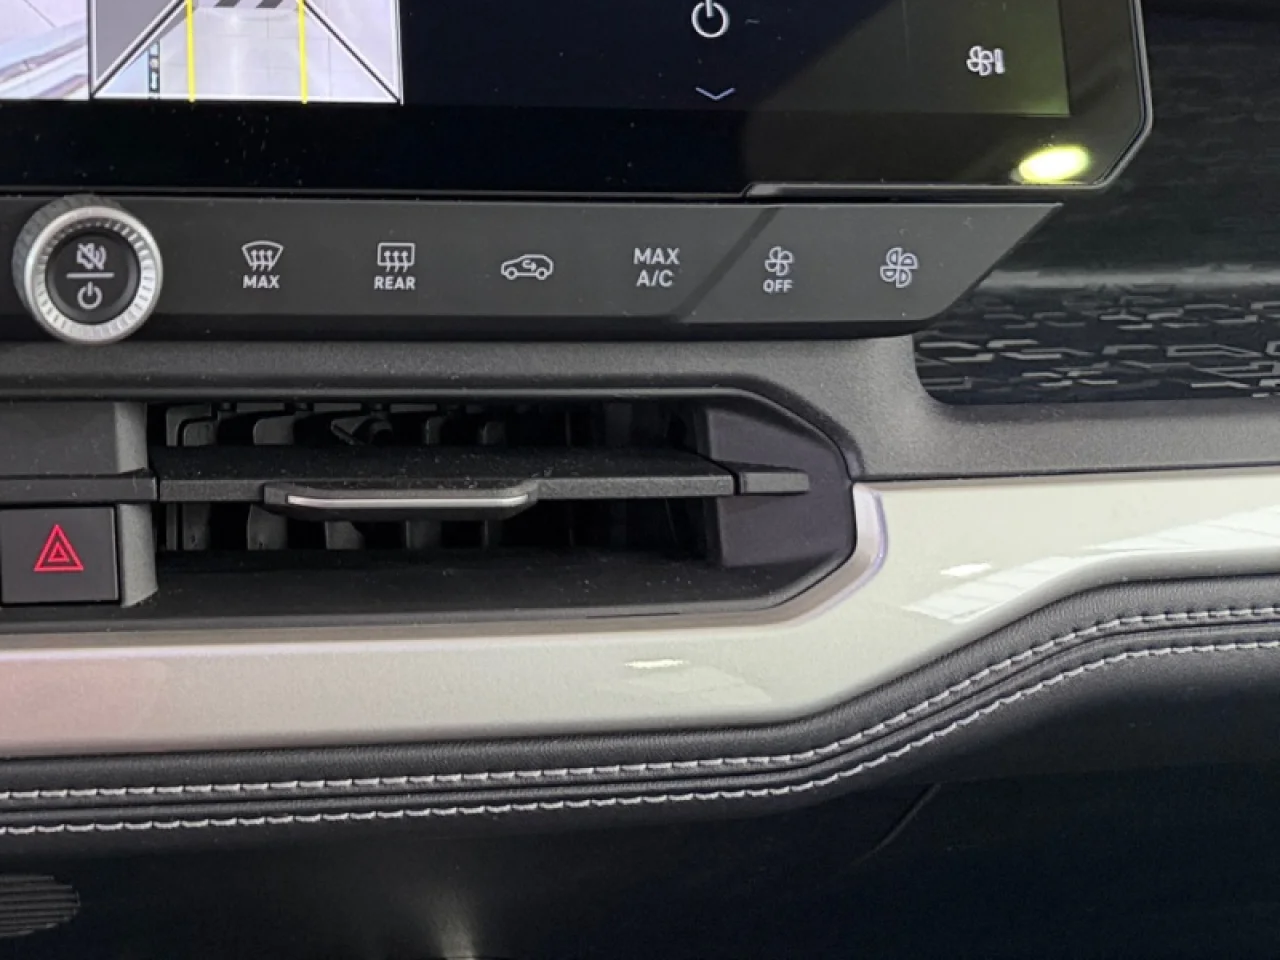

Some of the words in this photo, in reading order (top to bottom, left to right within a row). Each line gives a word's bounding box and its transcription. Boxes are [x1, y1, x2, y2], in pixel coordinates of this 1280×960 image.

[633, 247, 681, 266] MAX
[243, 274, 281, 290] MAX
[373, 275, 417, 291] REAR
[636, 269, 674, 288] A/C
[762, 279, 794, 294] OFF
